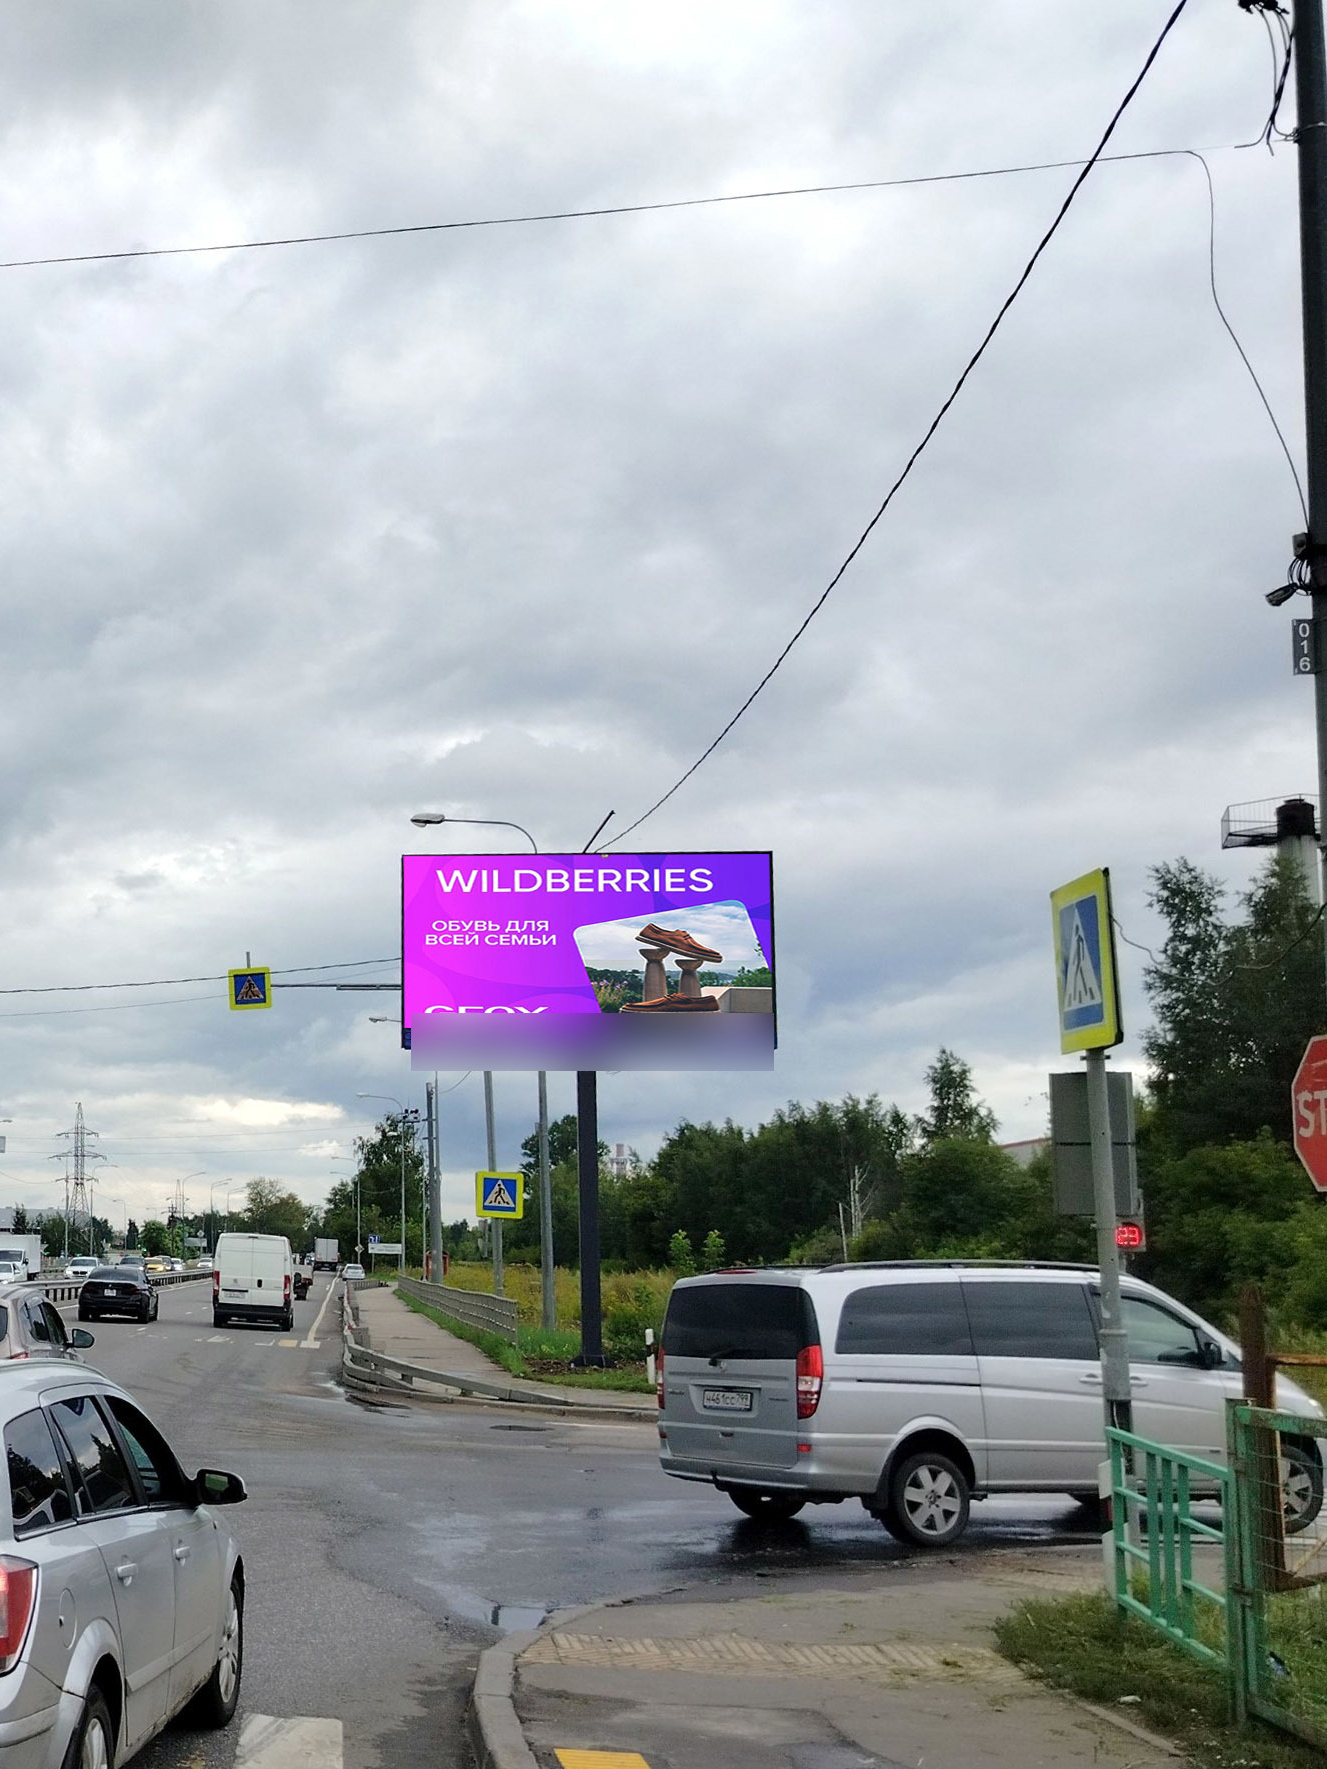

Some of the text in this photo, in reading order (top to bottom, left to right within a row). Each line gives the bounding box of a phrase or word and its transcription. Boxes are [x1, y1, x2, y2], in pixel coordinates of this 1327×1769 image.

[1299, 623, 1311, 671] 016
[435, 868, 714, 893] WILDBERRIES
[431, 920, 550, 934] ОБУВЬ ДЛЯ
[424, 932, 557, 946] ВСЕЙ СЕМЬИ
[1115, 1226, 1139, 1245] 23
